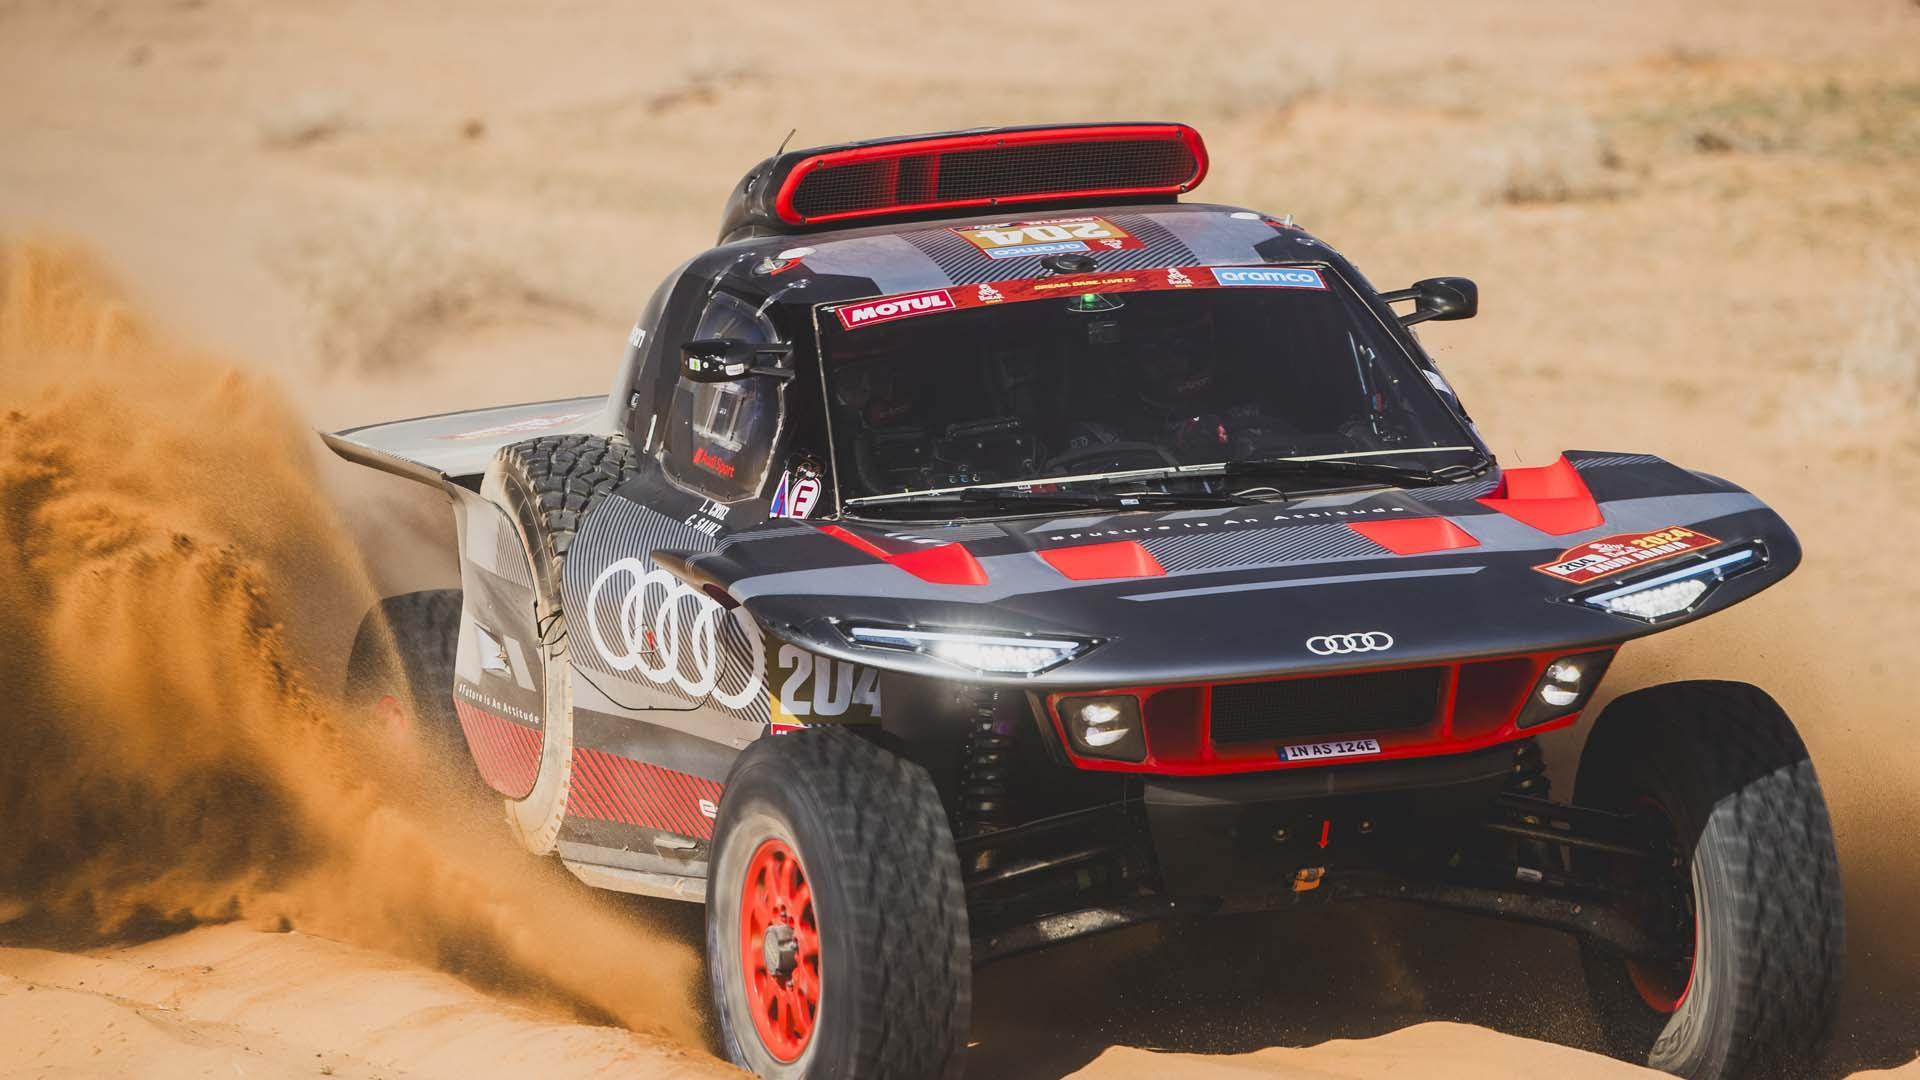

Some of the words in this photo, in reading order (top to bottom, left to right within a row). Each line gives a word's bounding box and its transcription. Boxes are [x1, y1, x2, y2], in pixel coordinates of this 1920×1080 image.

[976, 222, 1112, 245] 204
[994, 243, 1081, 255] aramco
[1222, 269, 1315, 283] aramco
[852, 294, 947, 323] MOTUL
[792, 485, 814, 517] E
[684, 513, 698, 526] C.
[693, 517, 723, 537] SAINZ
[1050, 526, 1171, 541] #Future
[1273, 507, 1404, 521] Attitude
[1630, 528, 1693, 548] 2024
[1558, 558, 1597, 572] 204
[1585, 556, 1637, 574] SAUDI
[1631, 541, 1692, 560] ARABIA
[778, 643, 882, 717] 204
[492, 697, 501, 710] An
[503, 702, 540, 724] Attitude
[1291, 745, 1309, 757] IN
[1313, 744, 1333, 755] AS
[1335, 740, 1376, 753] 124E
